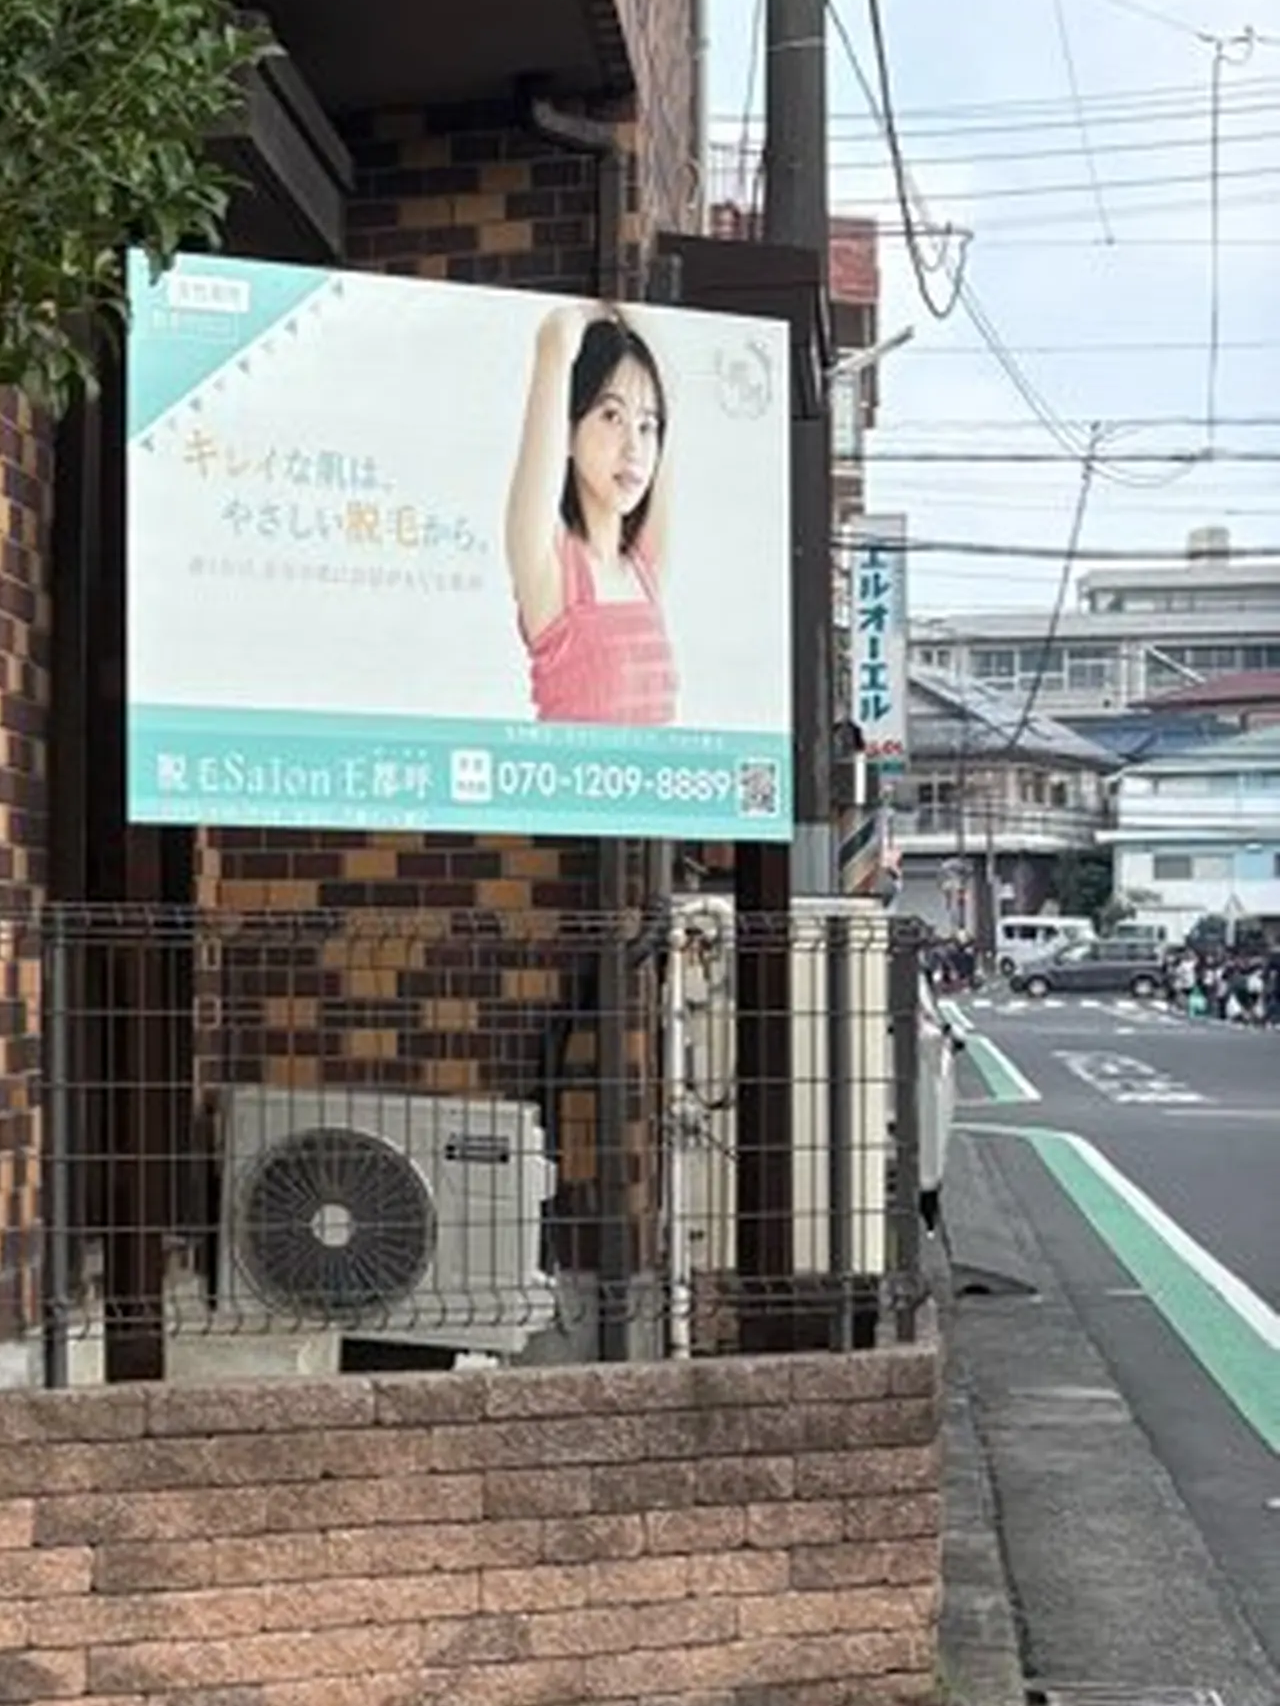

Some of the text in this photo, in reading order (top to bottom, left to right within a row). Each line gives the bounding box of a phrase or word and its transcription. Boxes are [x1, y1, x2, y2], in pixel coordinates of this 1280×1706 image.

[859, 547, 892, 721] エルオーエル
